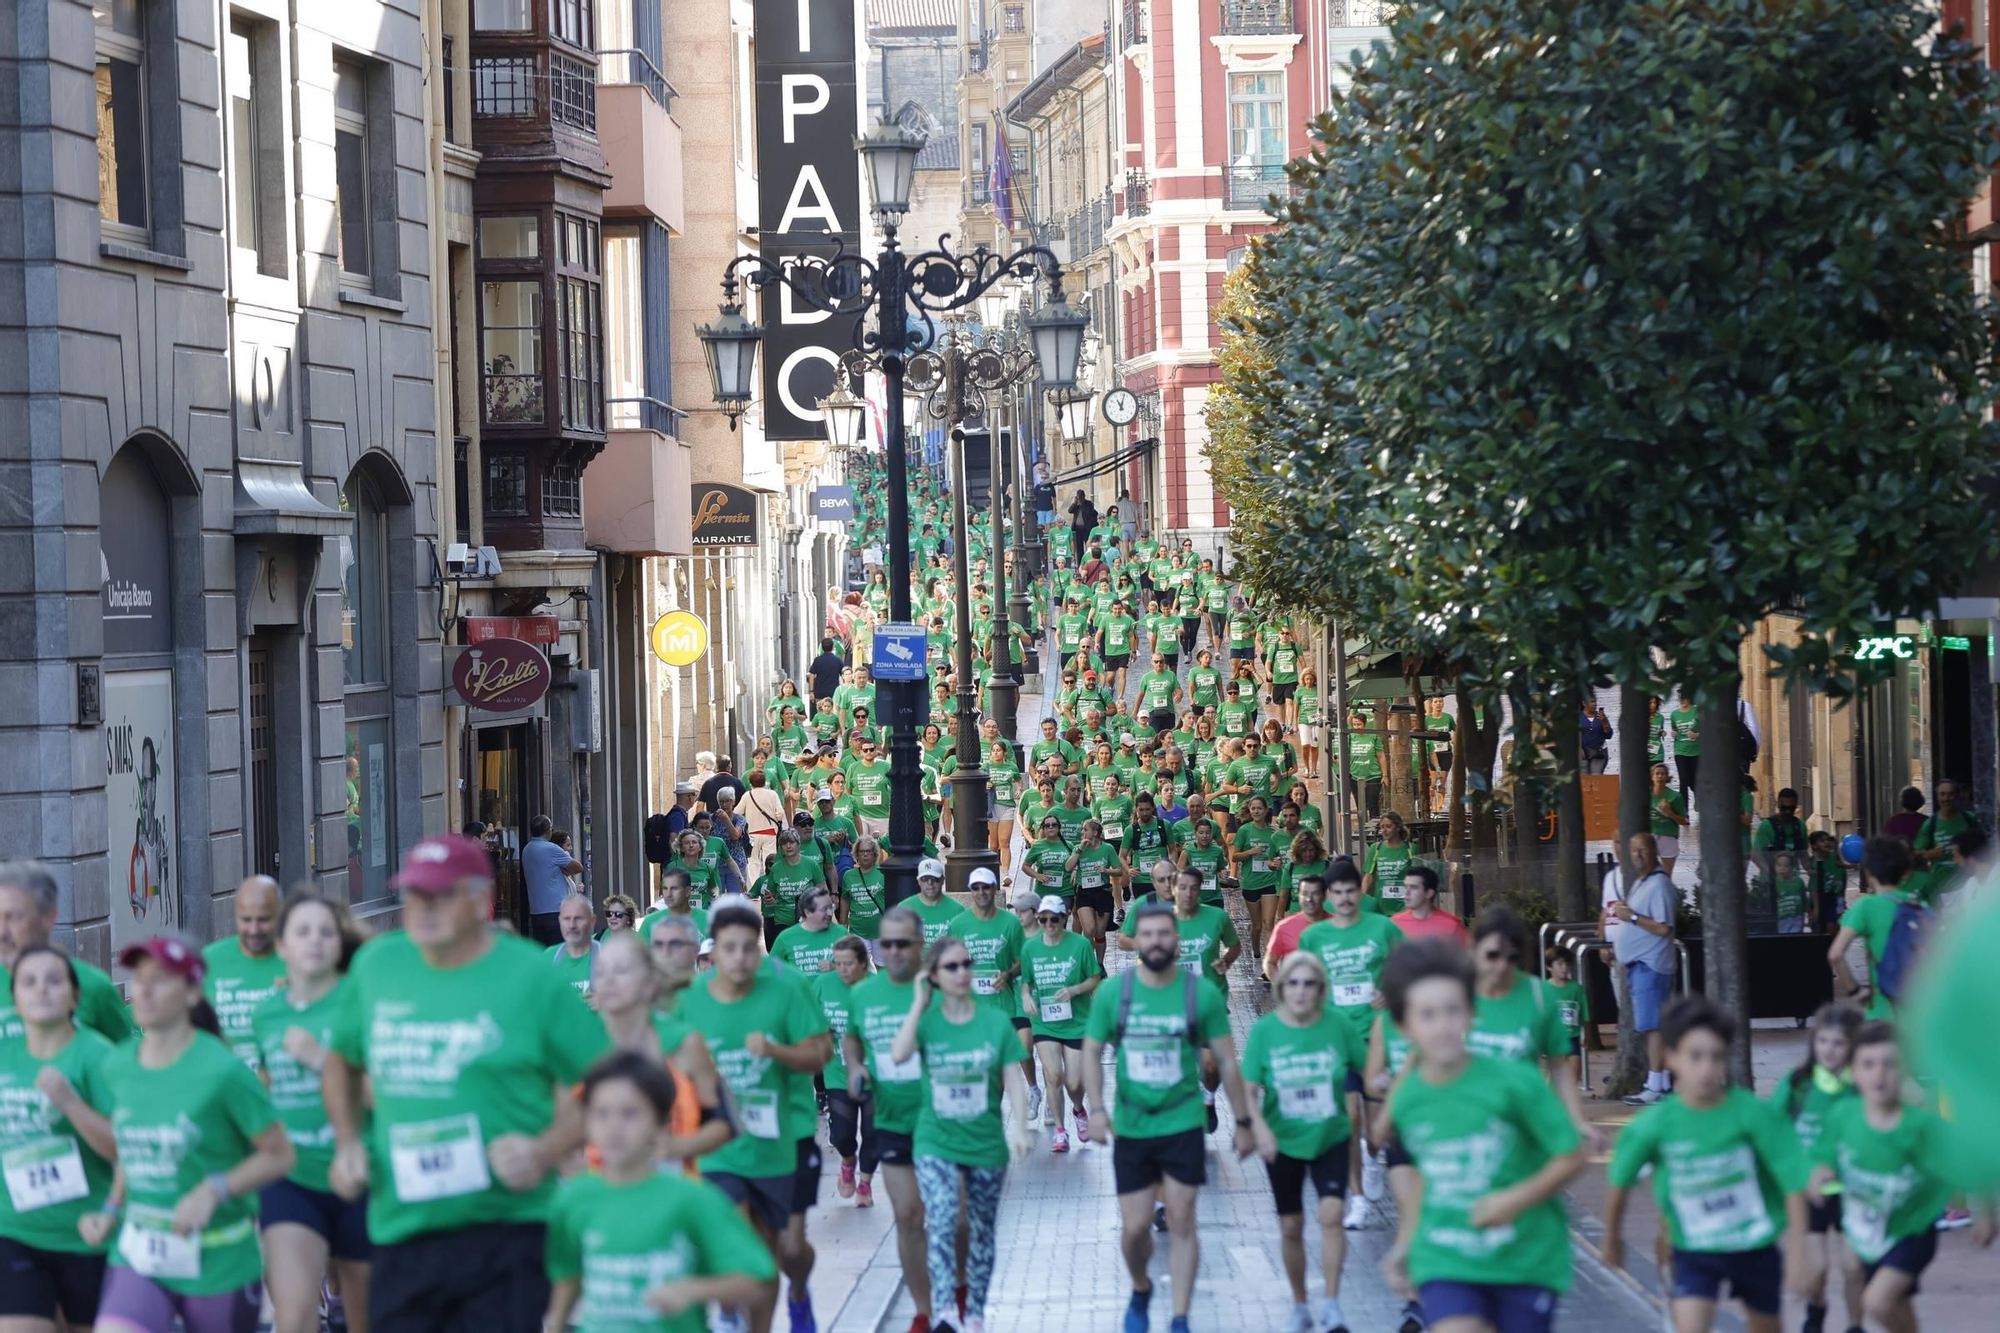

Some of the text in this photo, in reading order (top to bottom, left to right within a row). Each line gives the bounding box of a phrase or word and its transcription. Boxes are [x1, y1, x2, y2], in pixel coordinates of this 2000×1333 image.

[820, 498, 850, 507] BBVA
[108, 580, 152, 613] Unicaja Banco
[465, 658, 540, 701] Rialto
[114, 714, 133, 775] MÁS
[796, 957, 818, 965] contra
[1044, 961, 1071, 970] marcha
[1035, 970, 1056, 978] contra
[1049, 1005, 1062, 1014] 155
